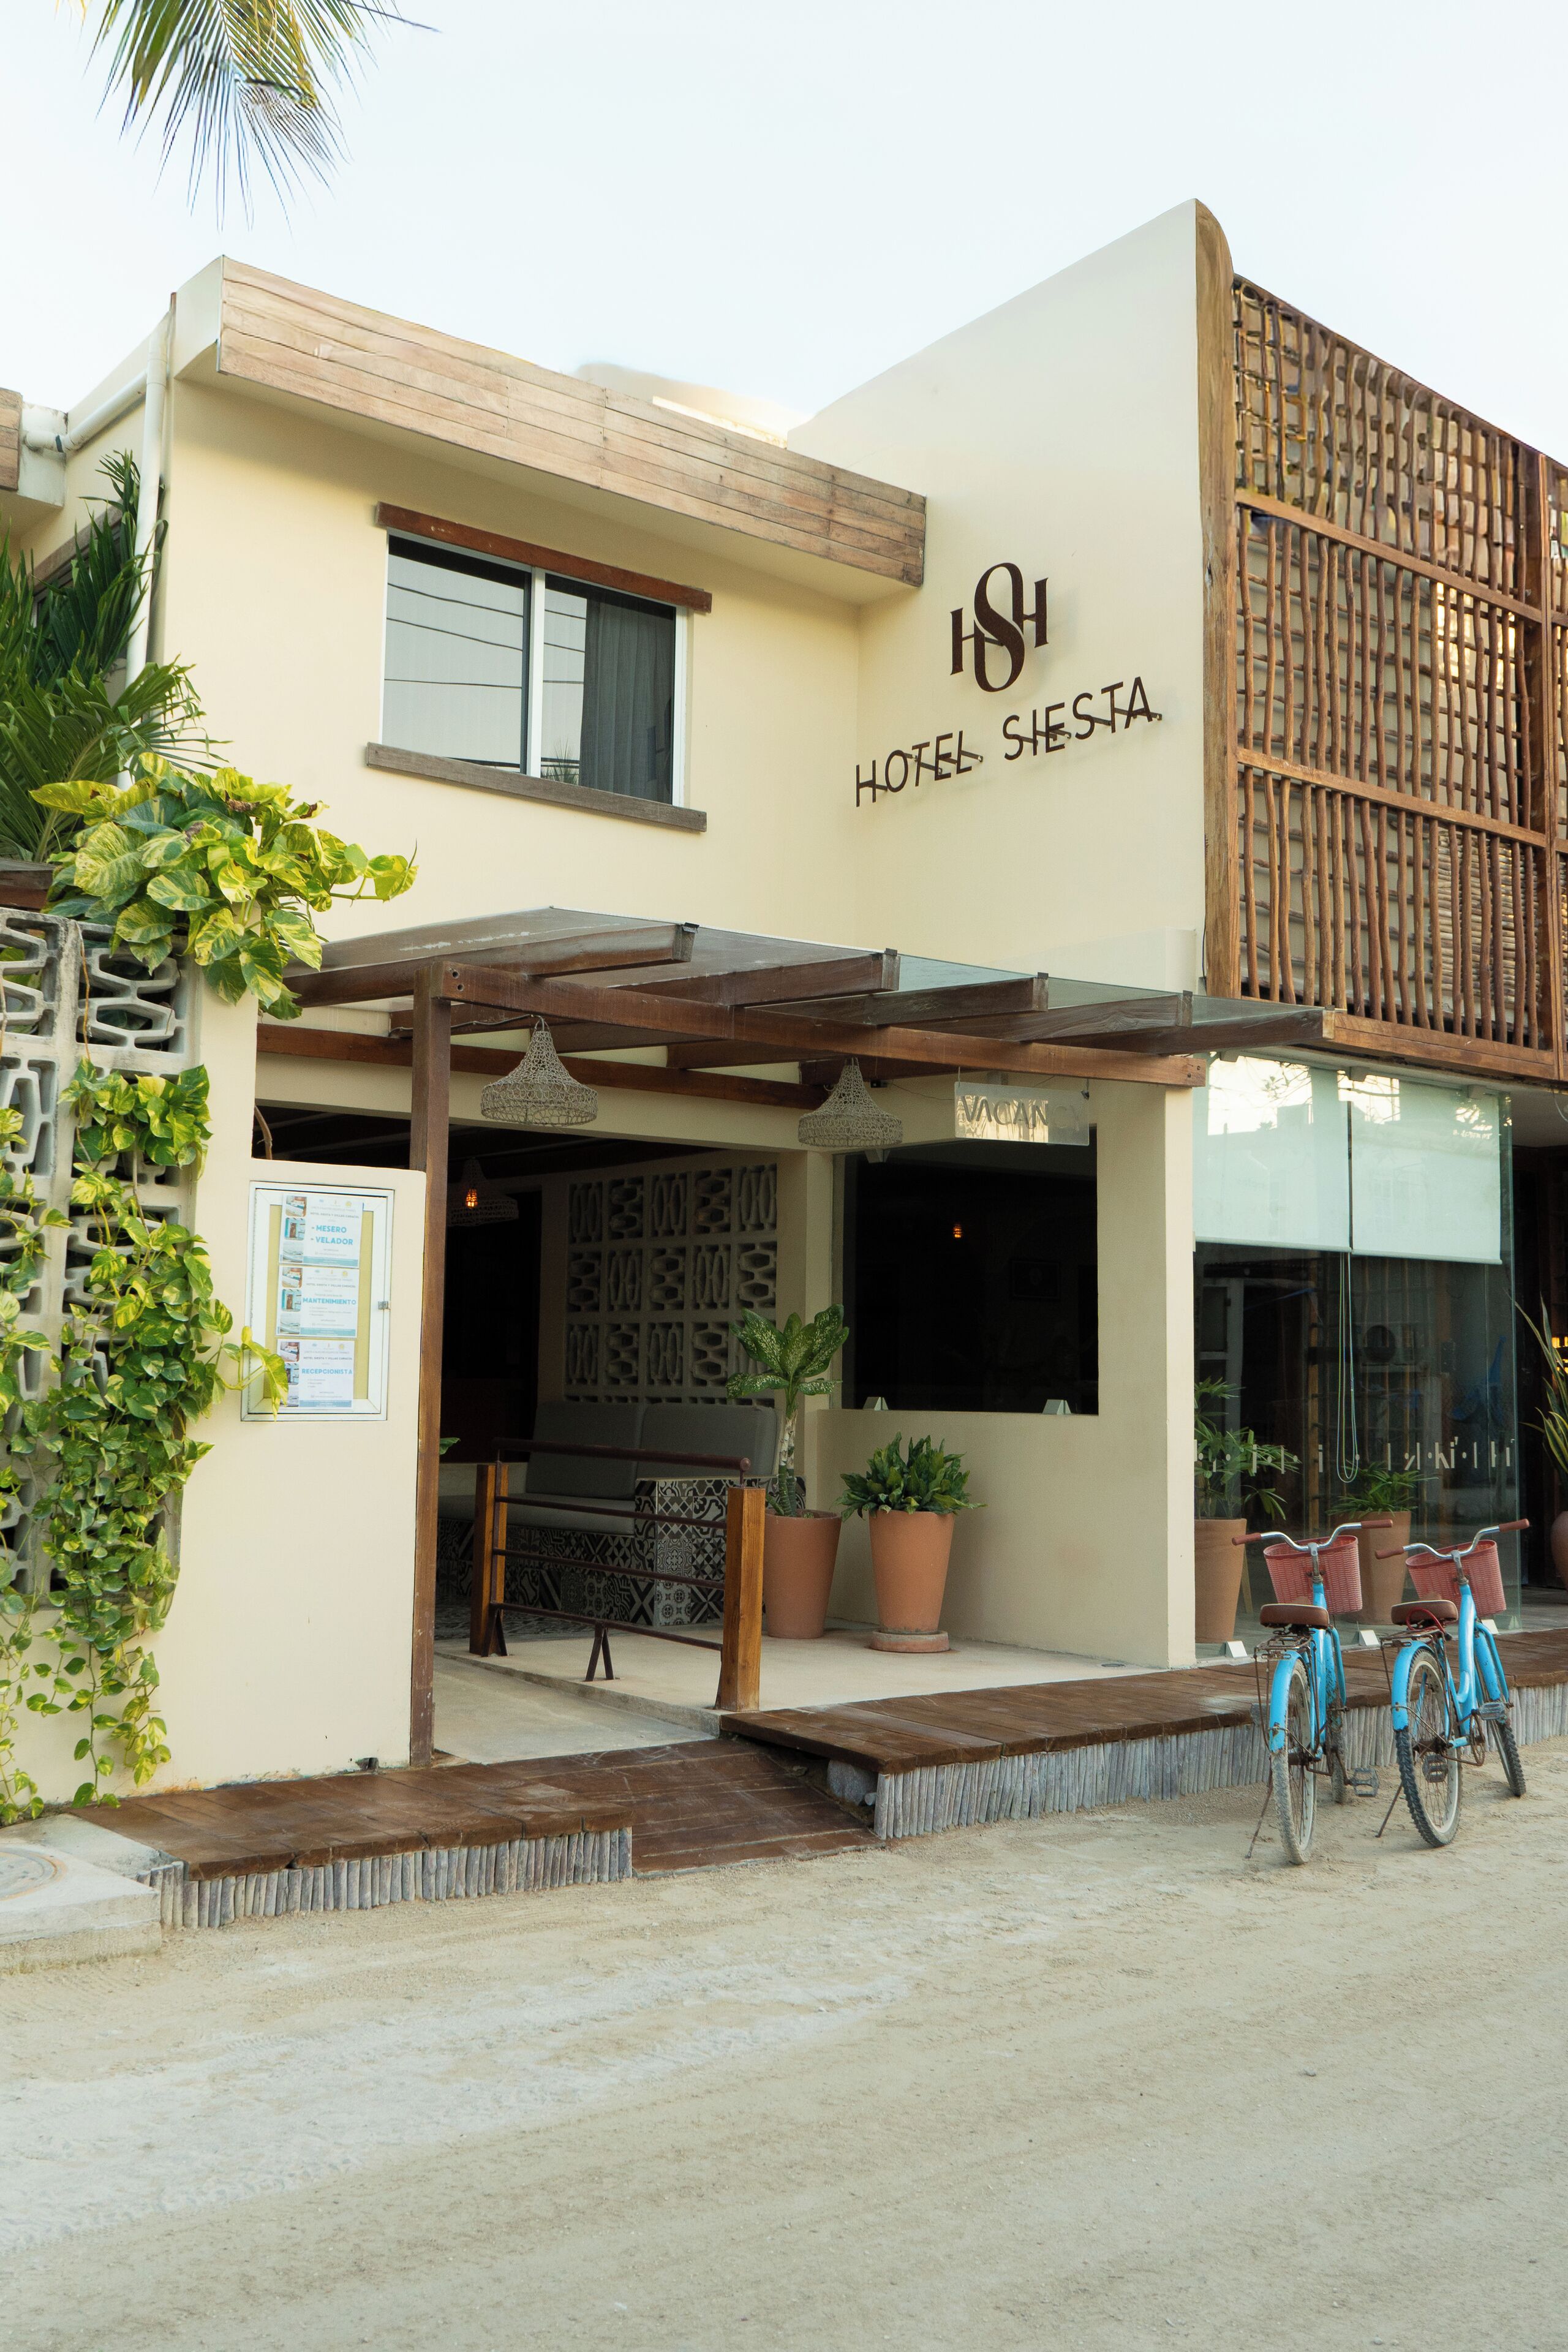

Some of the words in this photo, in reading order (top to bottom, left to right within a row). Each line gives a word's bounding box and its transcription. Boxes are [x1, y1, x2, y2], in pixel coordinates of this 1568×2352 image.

[856, 730, 973, 807] HOTEL
[1002, 676, 1153, 760] SIESTA
[316, 1225, 347, 1234] MESERO
[315, 1237, 353, 1245] VELADOR
